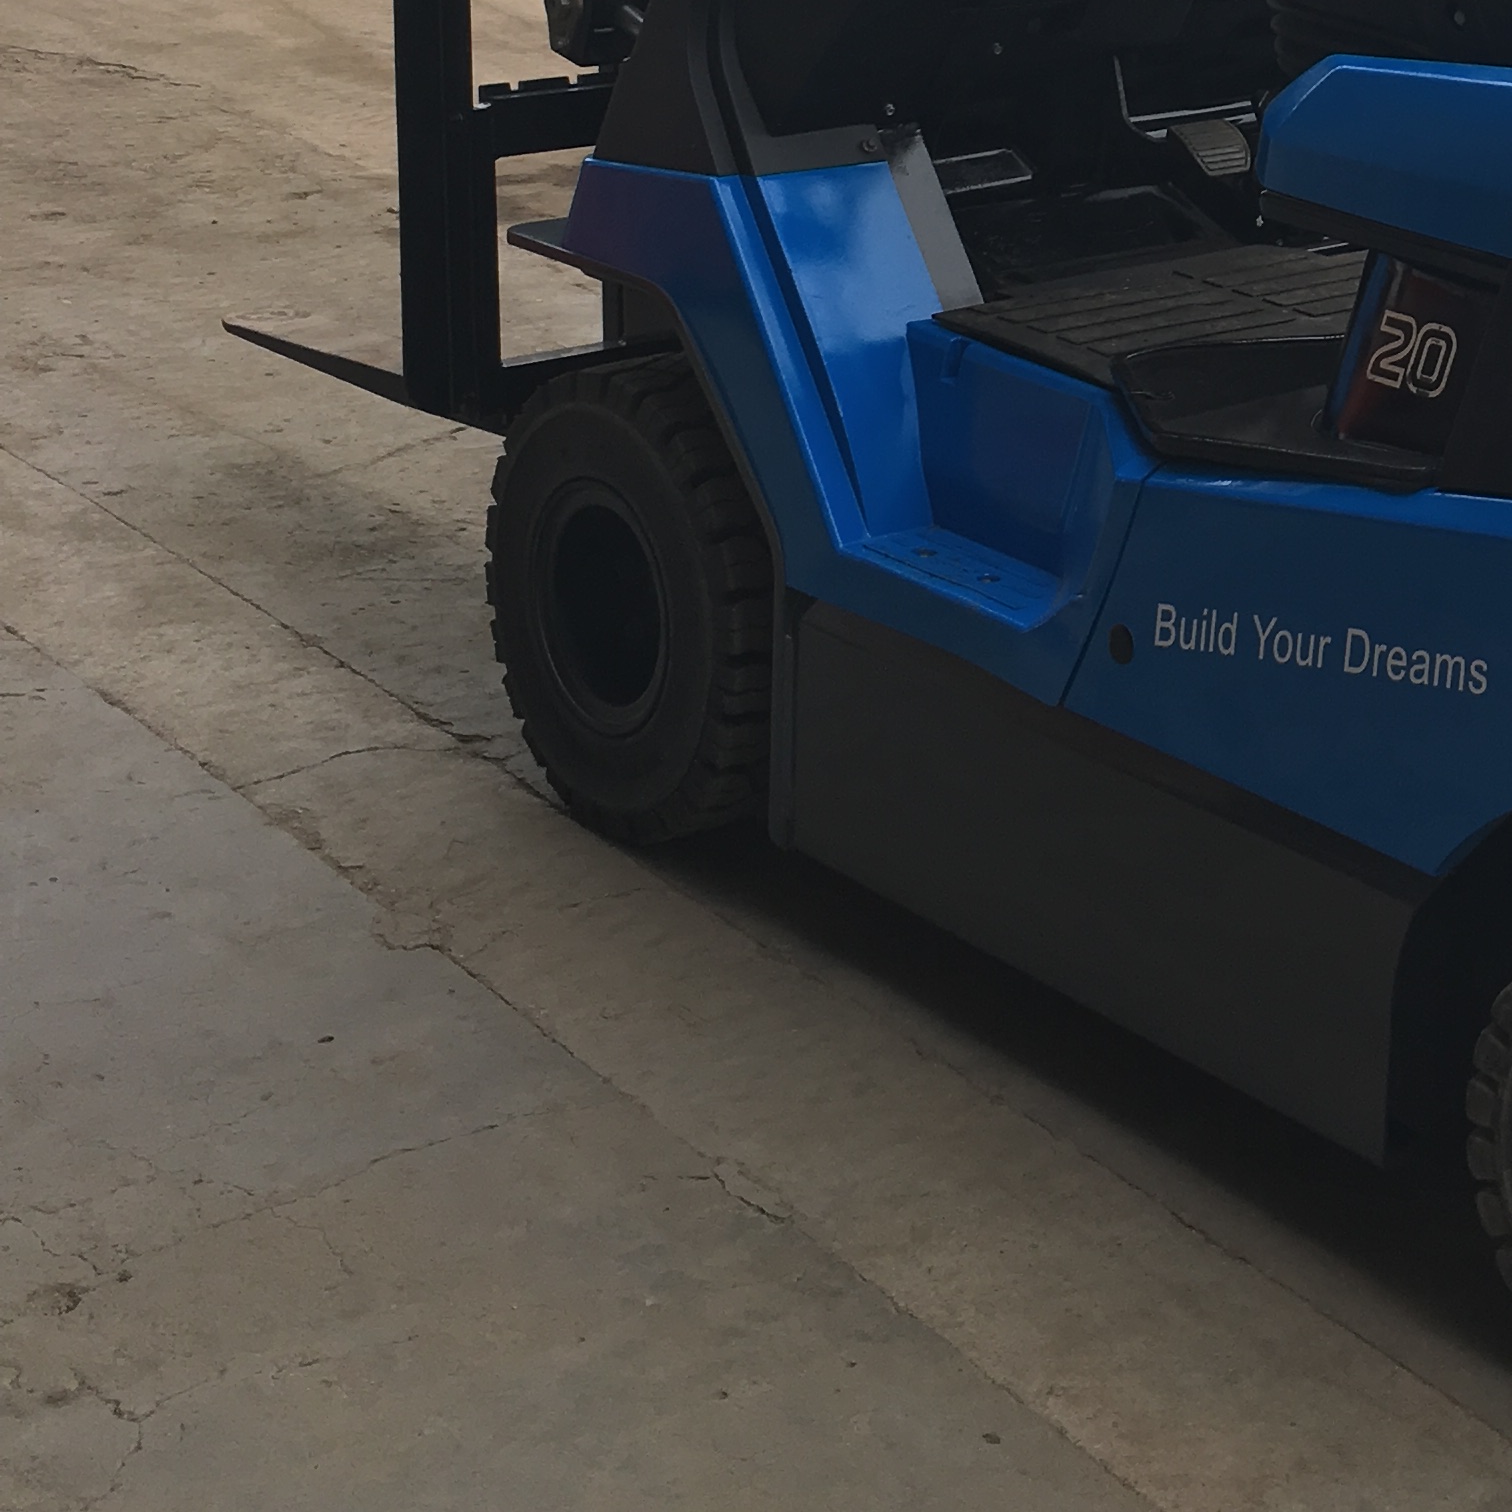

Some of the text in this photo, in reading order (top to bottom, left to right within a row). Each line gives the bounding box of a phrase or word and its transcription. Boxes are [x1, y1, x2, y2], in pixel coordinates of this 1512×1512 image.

[1366, 309, 1457, 398] 20
[1154, 602, 1488, 695] Build Your Dreams
